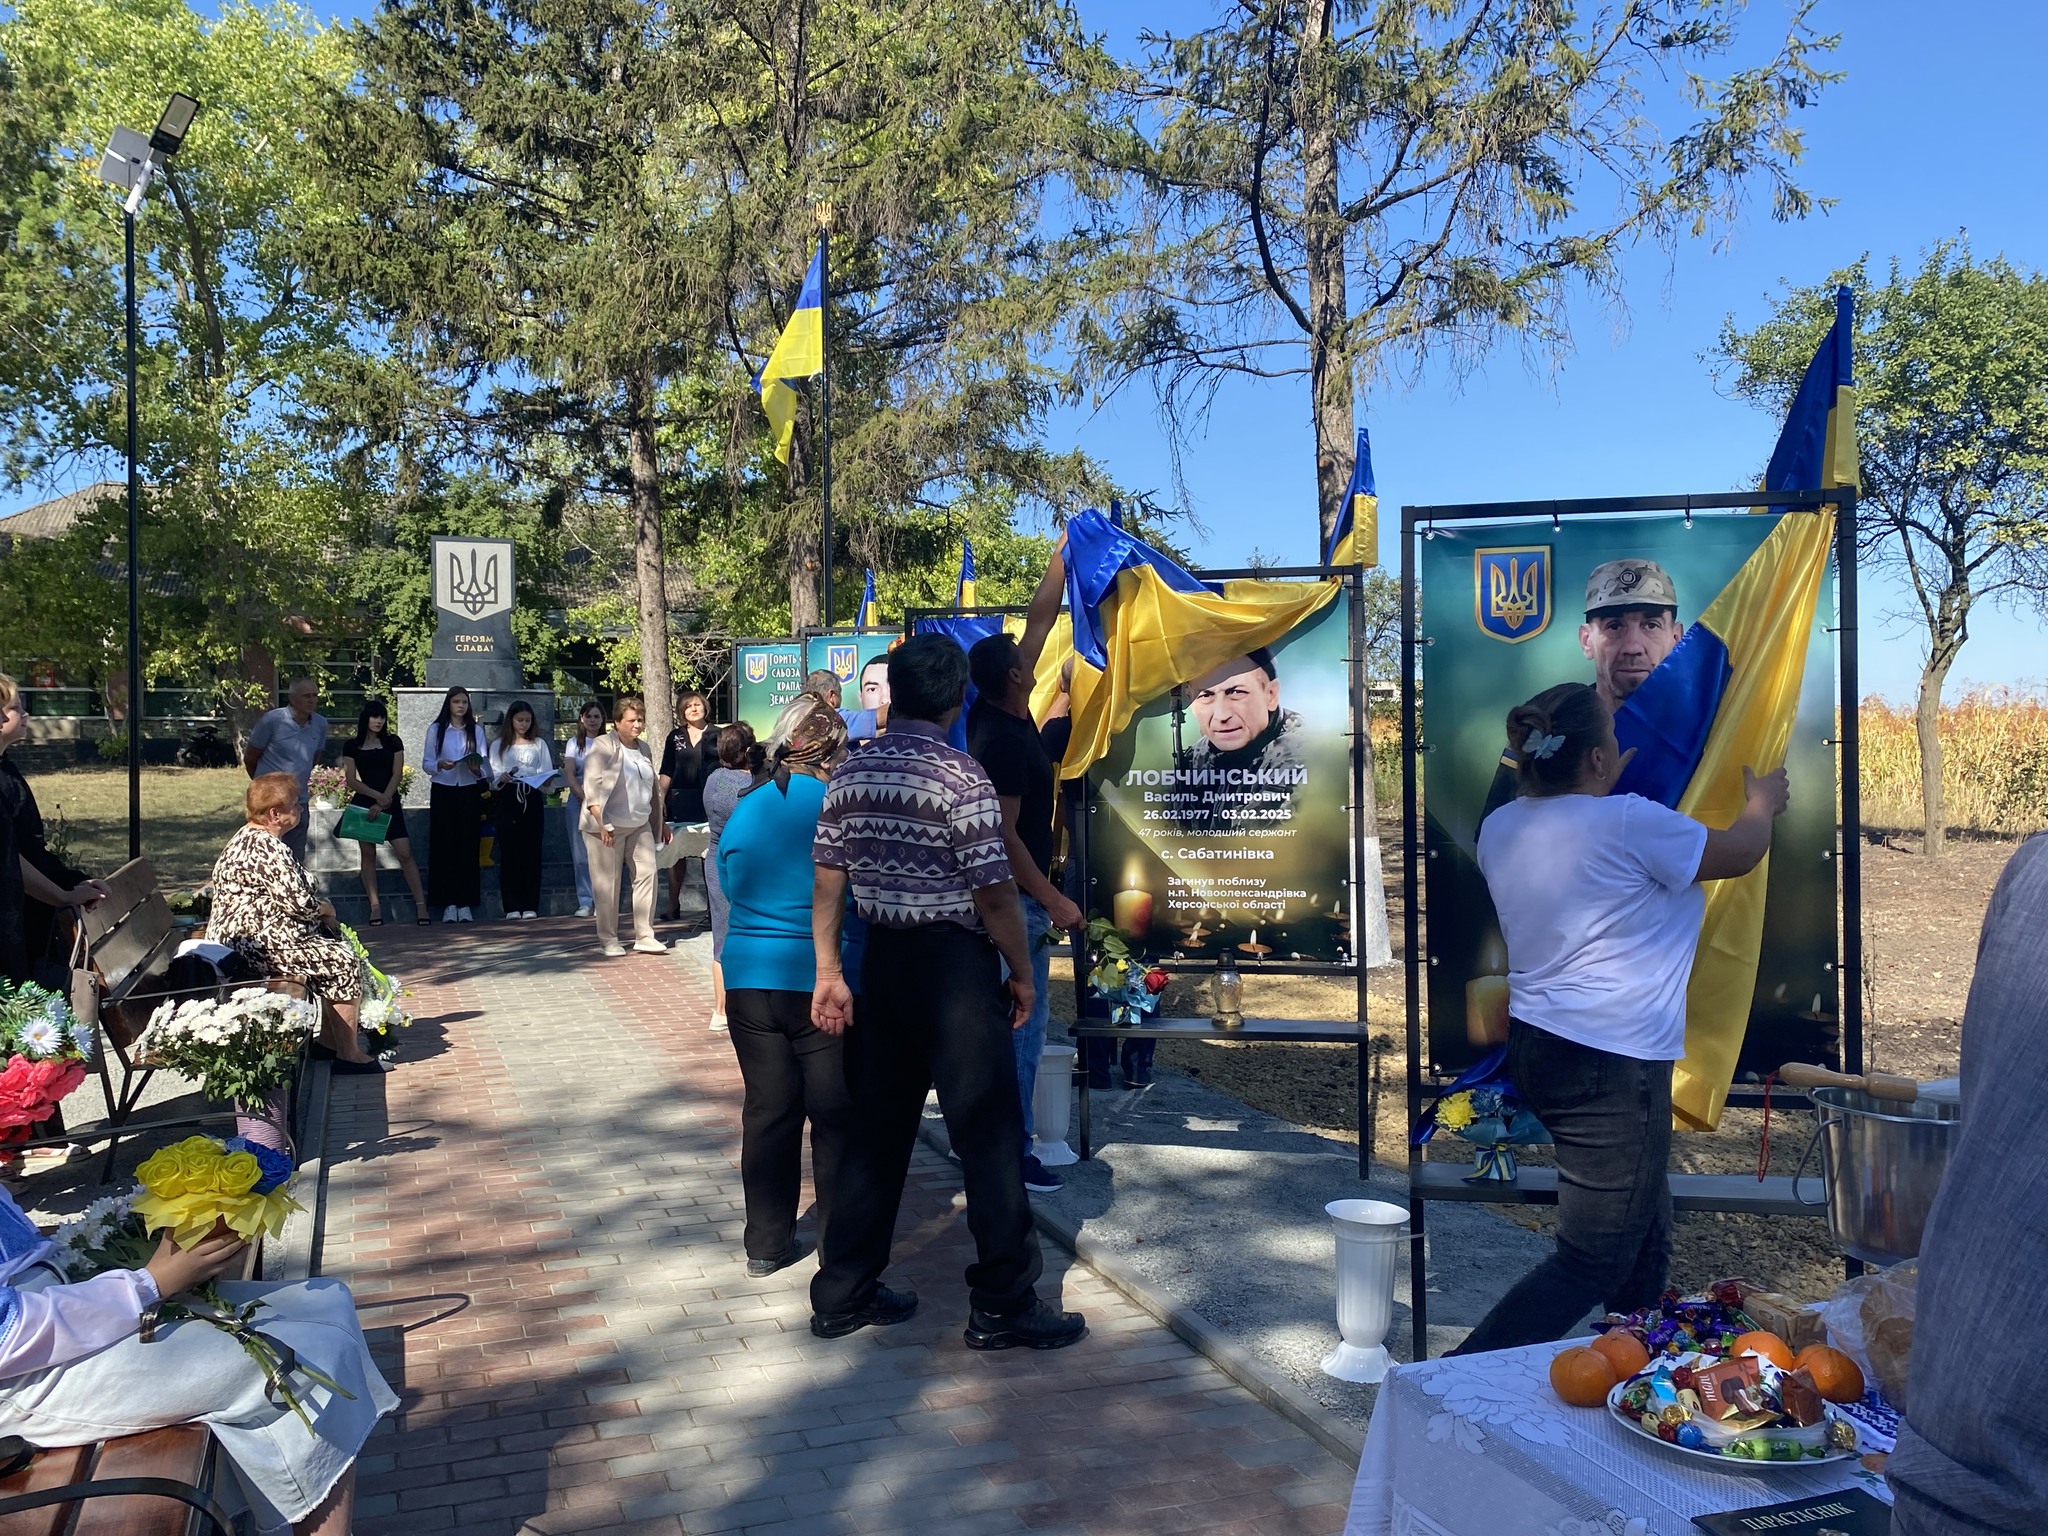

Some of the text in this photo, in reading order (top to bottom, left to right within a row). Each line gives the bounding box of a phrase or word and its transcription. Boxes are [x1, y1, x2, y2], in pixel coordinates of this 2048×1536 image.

[455, 635, 494, 643] ГЕРОЯМ
[455, 644, 494, 652] СЛАВА!
[1126, 765, 1308, 786] ЛОБЧИНСЬКИЙ
[1144, 790, 1291, 804] Василь Дмитрович
[1143, 809, 1210, 820] 26.02.1977
[1221, 809, 1292, 820] 03.02.2025
[1138, 827, 1298, 838] 47 років, молодший сержант
[1161, 846, 1275, 860] с. Сабатинівка
[1167, 876, 1267, 888] Загинув поблизу
[1168, 887, 1307, 899] н.п. Новоолександрівка
[1168, 899, 1286, 910] Херсонської області
[1740, 1502, 1856, 1531] ПАРАСТАСНИК
